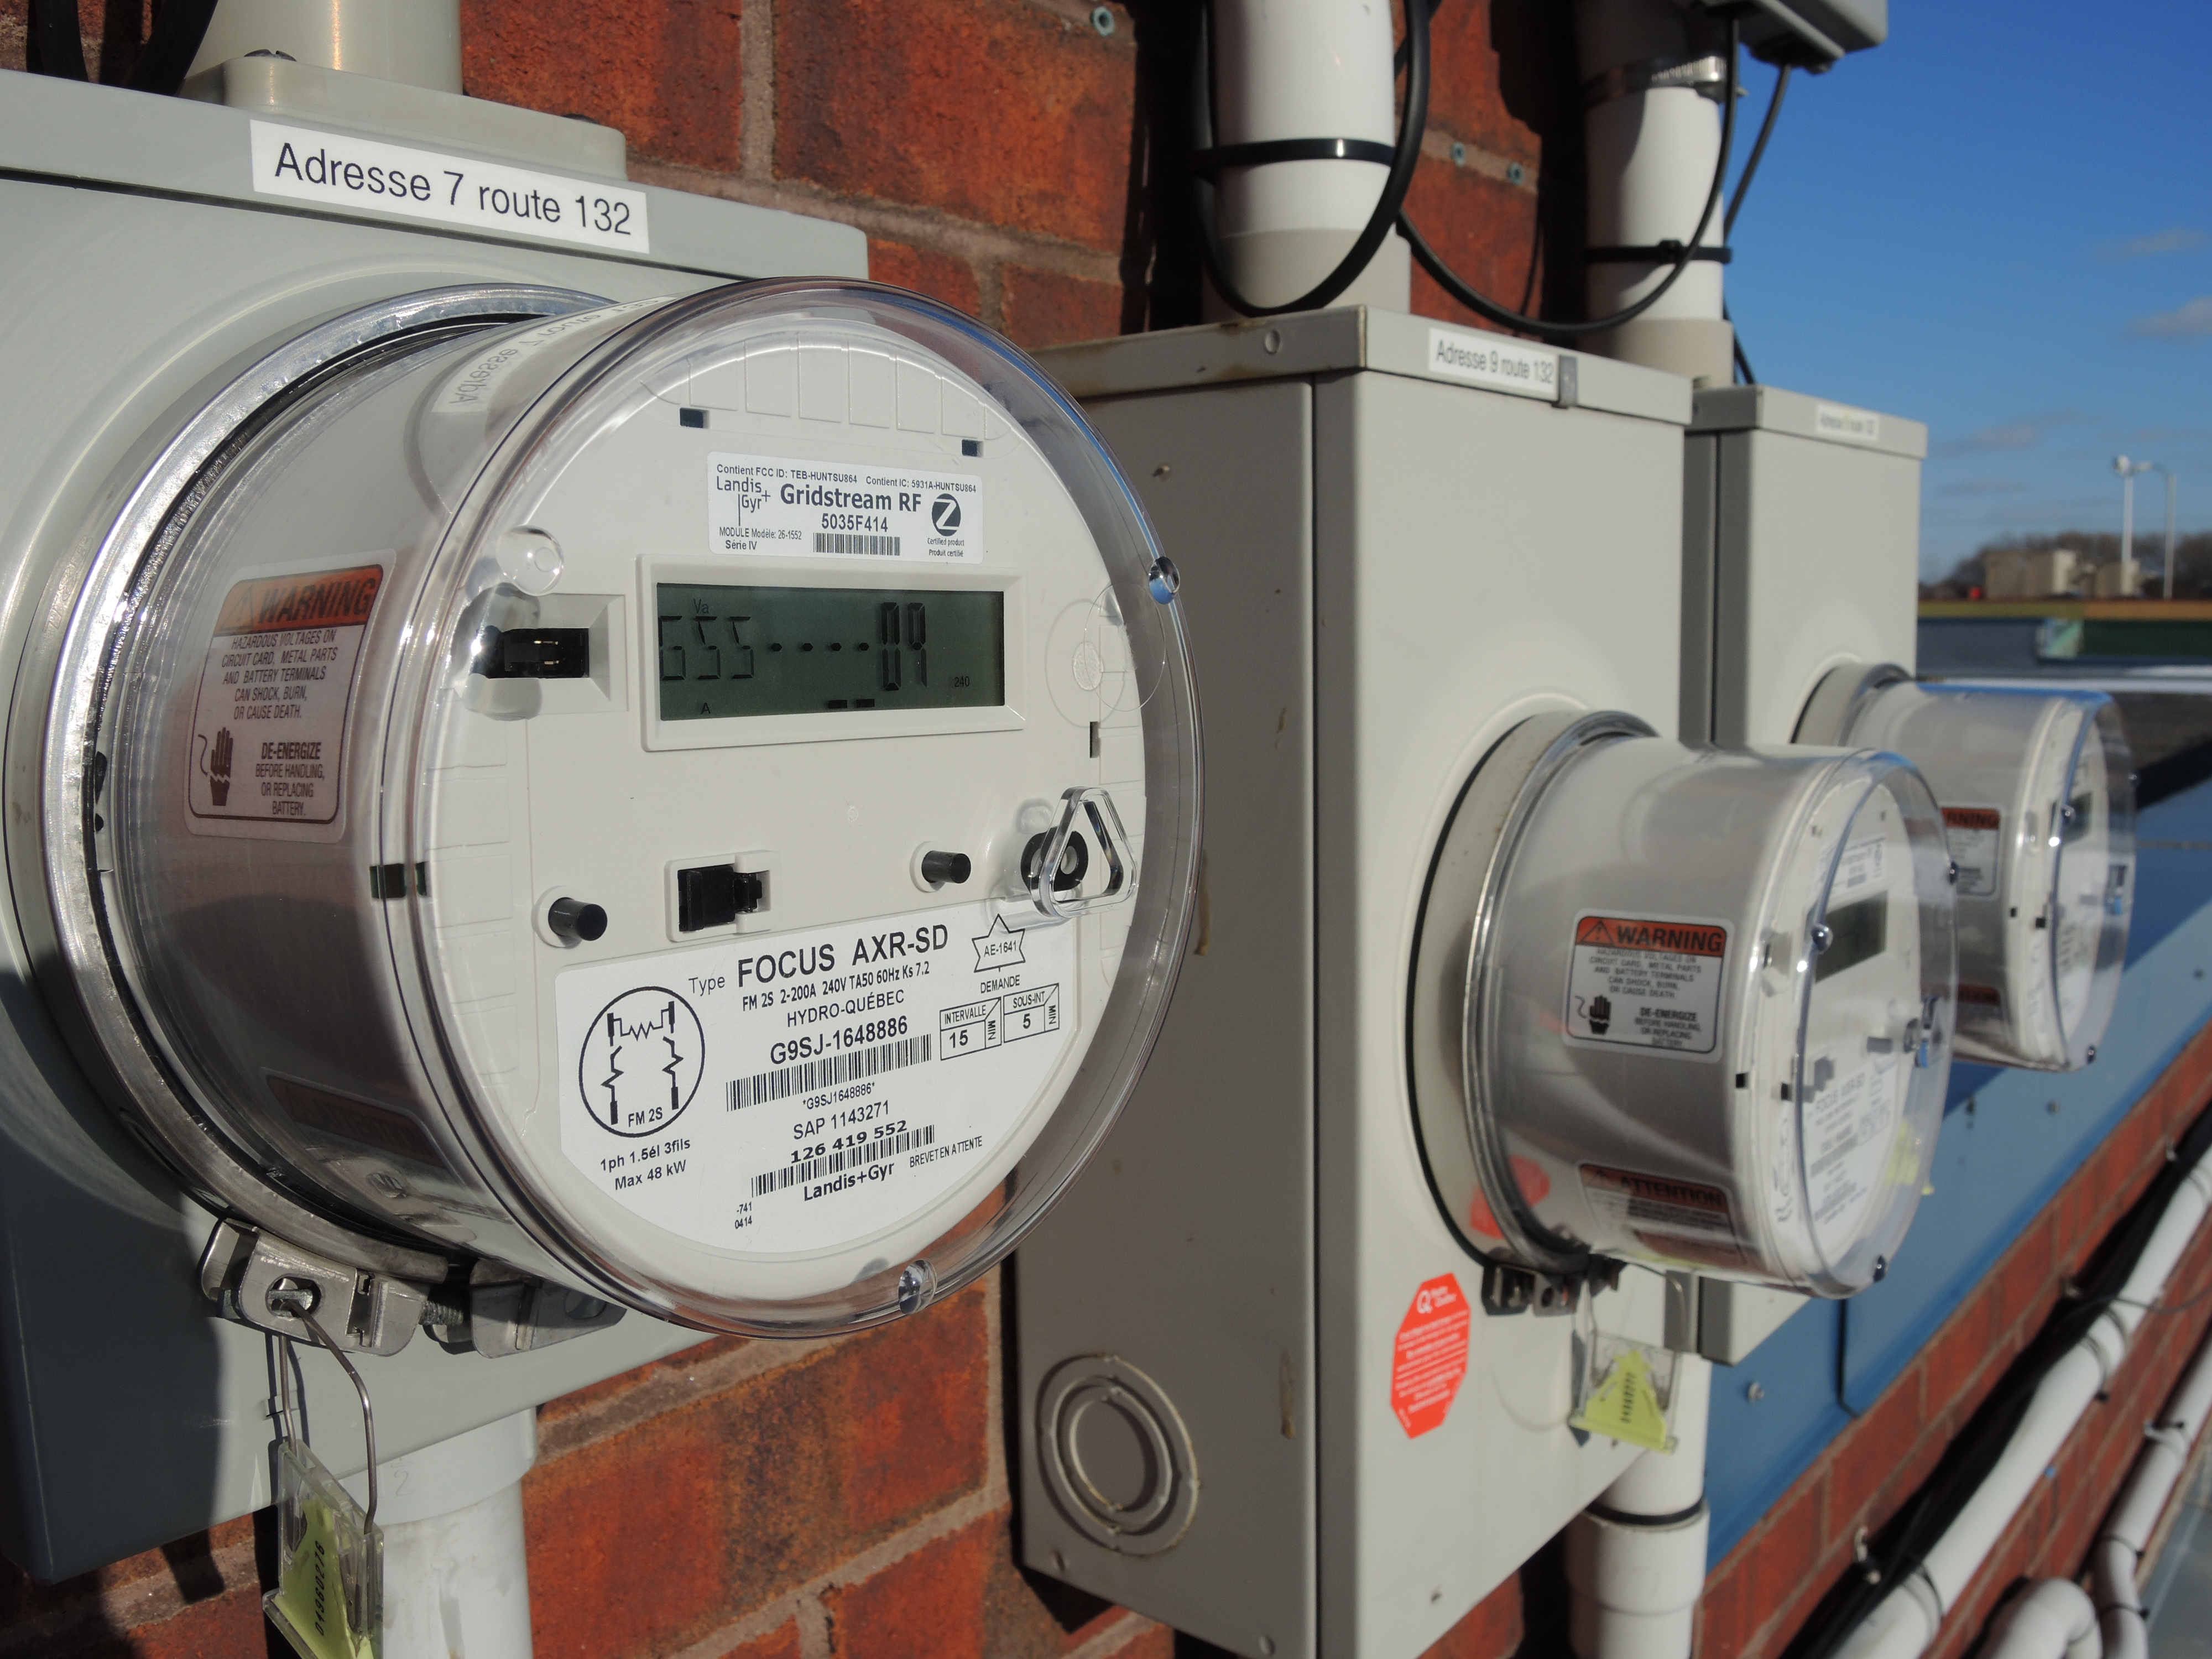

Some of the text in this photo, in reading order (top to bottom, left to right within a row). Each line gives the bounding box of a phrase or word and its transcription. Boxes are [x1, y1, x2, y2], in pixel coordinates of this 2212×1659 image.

[274, 143, 631, 236] Adresse 7 route 132
[1437, 340, 1554, 384] Adresse 9 route 132
[717, 464, 857, 483] Contient FCC ID: TEB-HUNTSU864
[866, 476, 976, 493] Contient IC: 5931A-HUNTSU864
[780, 483, 921, 512] Gridstream RF
[719, 526, 802, 540] MODULE Modèle: 26-1552
[821, 513, 888, 533] 5035F414
[726, 539, 757, 550] Série IV
[948, 538, 964, 546] product
[258, 578, 375, 623] WARNING
[231, 629, 337, 650] HAZARDOUS VOLTAGES ON
[221, 653, 252, 667] CIRCUIT
[281, 649, 306, 664] METAL
[310, 647, 338, 661] PARTS
[223, 666, 327, 685] AND BATTERY TERMINALS
[954, 676, 970, 687] 240
[234, 686, 307, 702] CAN SHOCK, BURN,
[234, 704, 301, 719] OR CAUSE DEATH.
[261, 742, 321, 760] DE-ENERGIZE
[255, 763, 325, 781] BEFORE HANDLING,
[261, 782, 314, 797] OR REPLACING
[272, 801, 306, 816] BATTERY.
[984, 940, 1016, 957] AE-1641
[1618, 925, 1722, 952] WARNING
[688, 924, 948, 997] Type FOCUS AXR-SD
[743, 961, 930, 1011] FM 2S 2-200A 240V TA50 60Hz Ks 7.2
[980, 974, 1020, 994] DEMANDE
[787, 989, 905, 1027] HYDRO-QUÉBEC
[1013, 991, 1045, 1009] SOUS-INT
[945, 1005, 986, 1025] INTERVALLE
[1023, 1013, 1031, 1029] 5
[770, 1015, 907, 1065] G9SJ-1648886
[950, 1030, 968, 1048] 15
[988, 1020, 996, 1040] MIN
[628, 1107, 662, 1127] FM 2S
[794, 1099, 889, 1140] SAP 1143271
[791, 1120, 907, 1164] 126 419 552
[910, 1135, 983, 1168] BREVET EN ATTENTE
[601, 1138, 691, 1172] 1ph 1.5él 3fils
[615, 1160, 686, 1190] Max 48 kW
[804, 1161, 895, 1202] Landis+Gyr
[737, 1201, 752, 1214] -741
[734, 1215, 753, 1229] 0414
[315, 1540, 325, 1636] 04960276
